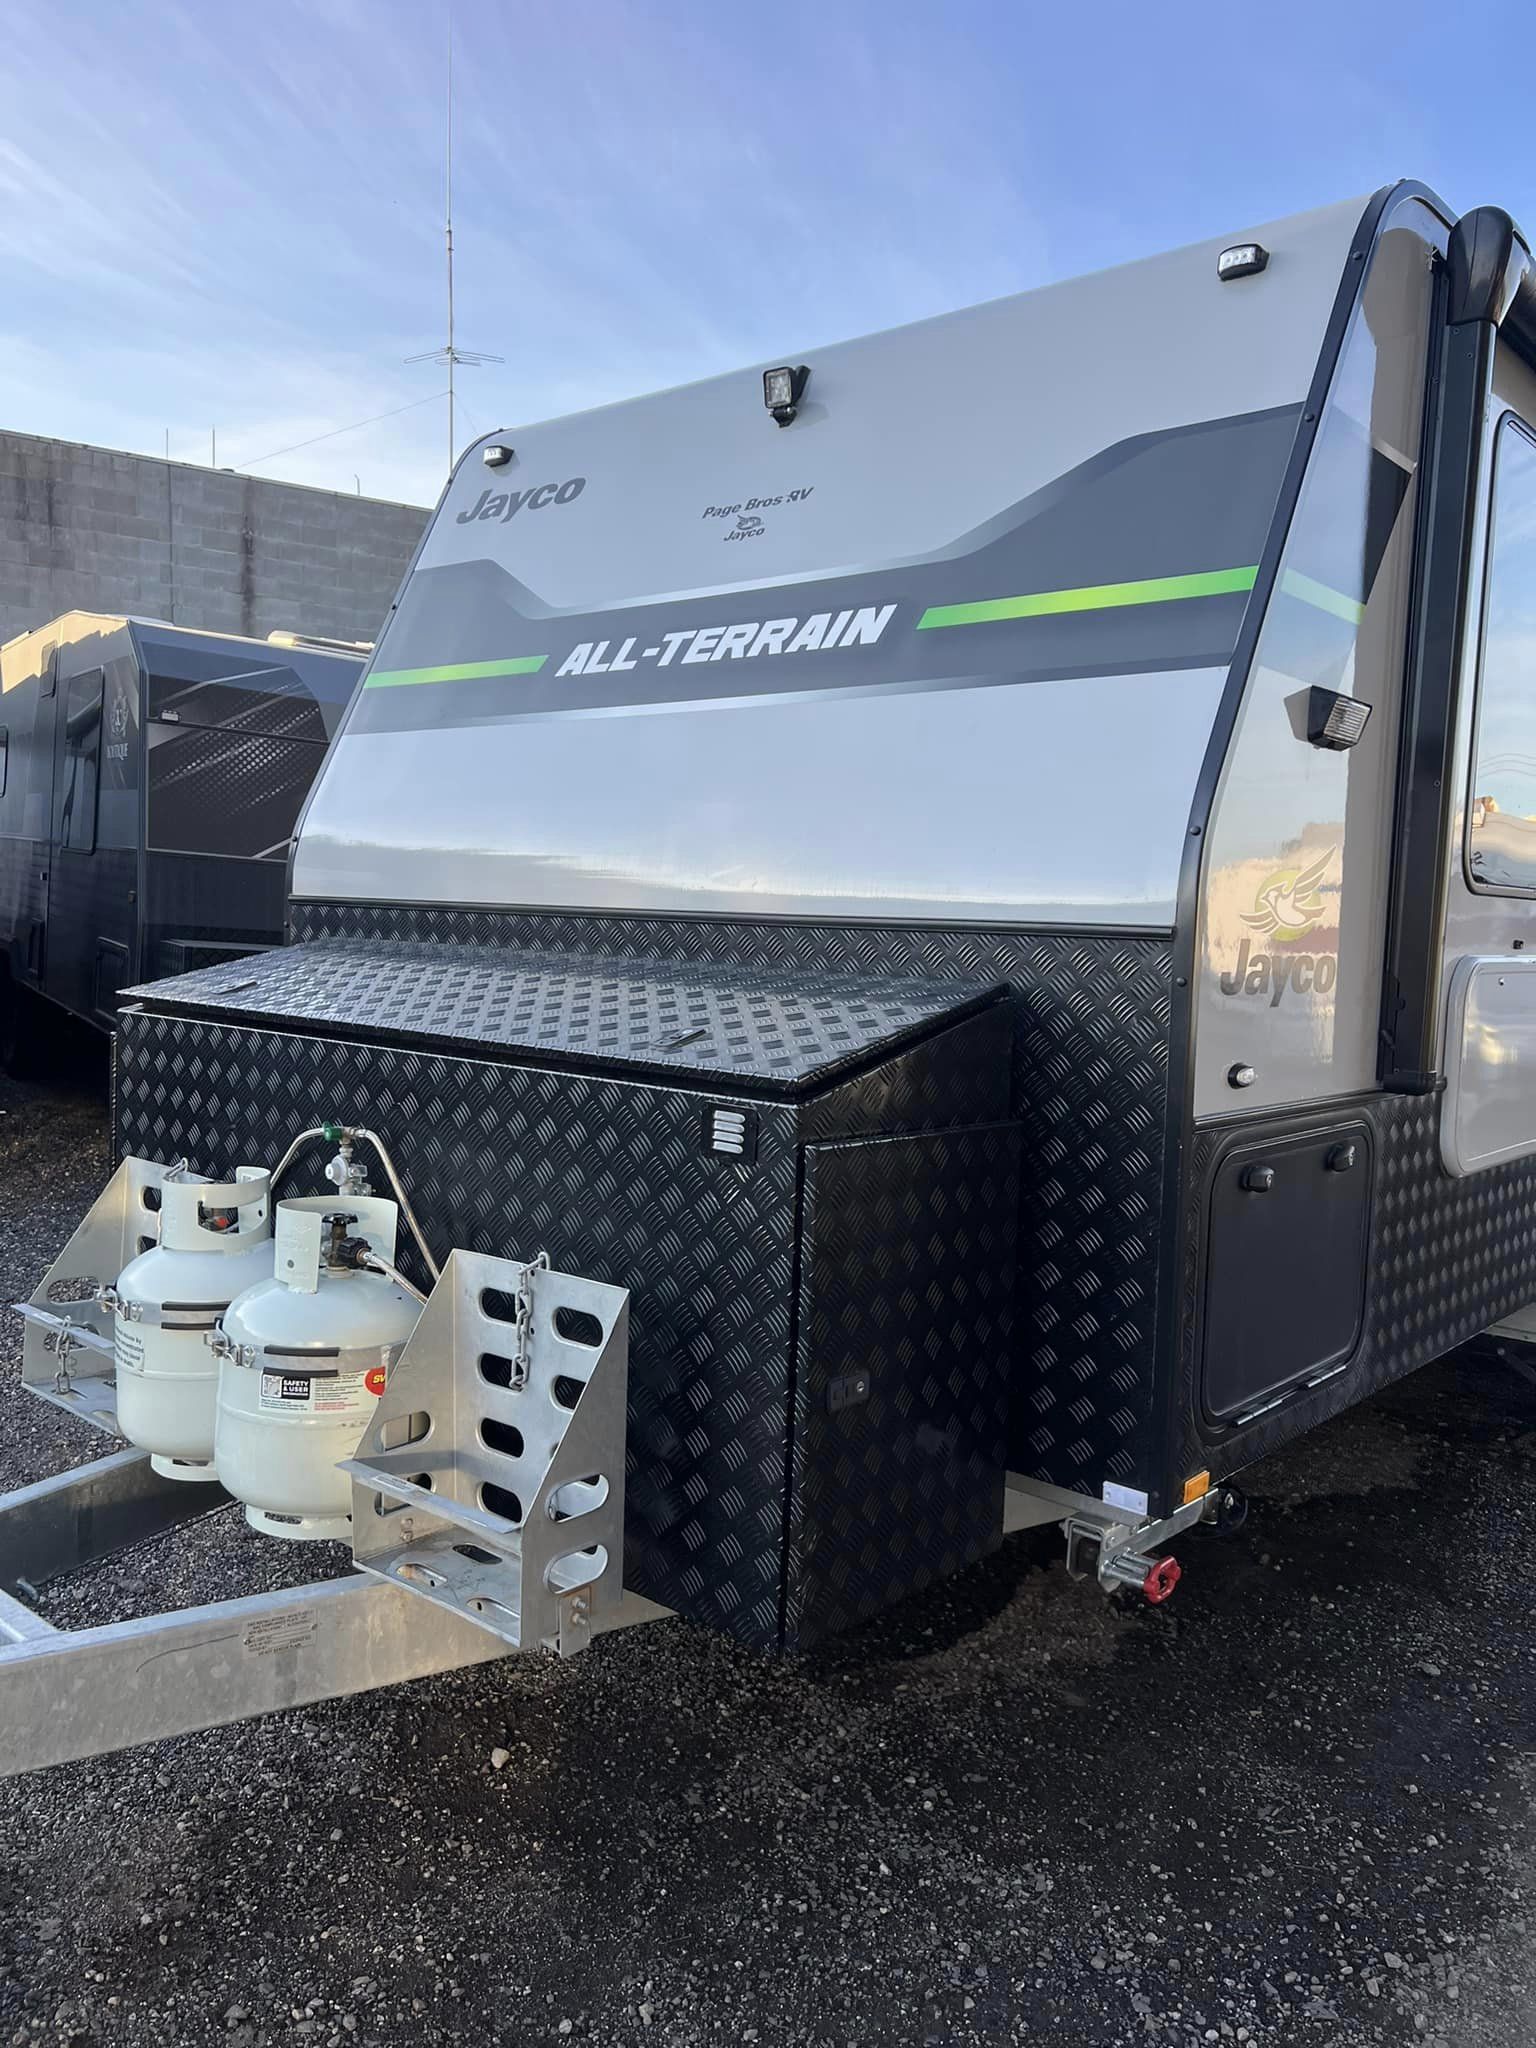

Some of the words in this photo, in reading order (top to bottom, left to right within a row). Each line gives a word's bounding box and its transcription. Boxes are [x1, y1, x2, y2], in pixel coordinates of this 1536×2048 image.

[456, 477, 586, 524] Jayco
[702, 503, 742, 518] Page
[744, 495, 784, 511] Bros
[786, 486, 815, 503] RV
[723, 527, 766, 541] Jayco
[554, 604, 898, 678] ALL-TERRAIN
[1220, 938, 1337, 1008] Jayco
[283, 1379, 309, 1387] SAFETY
